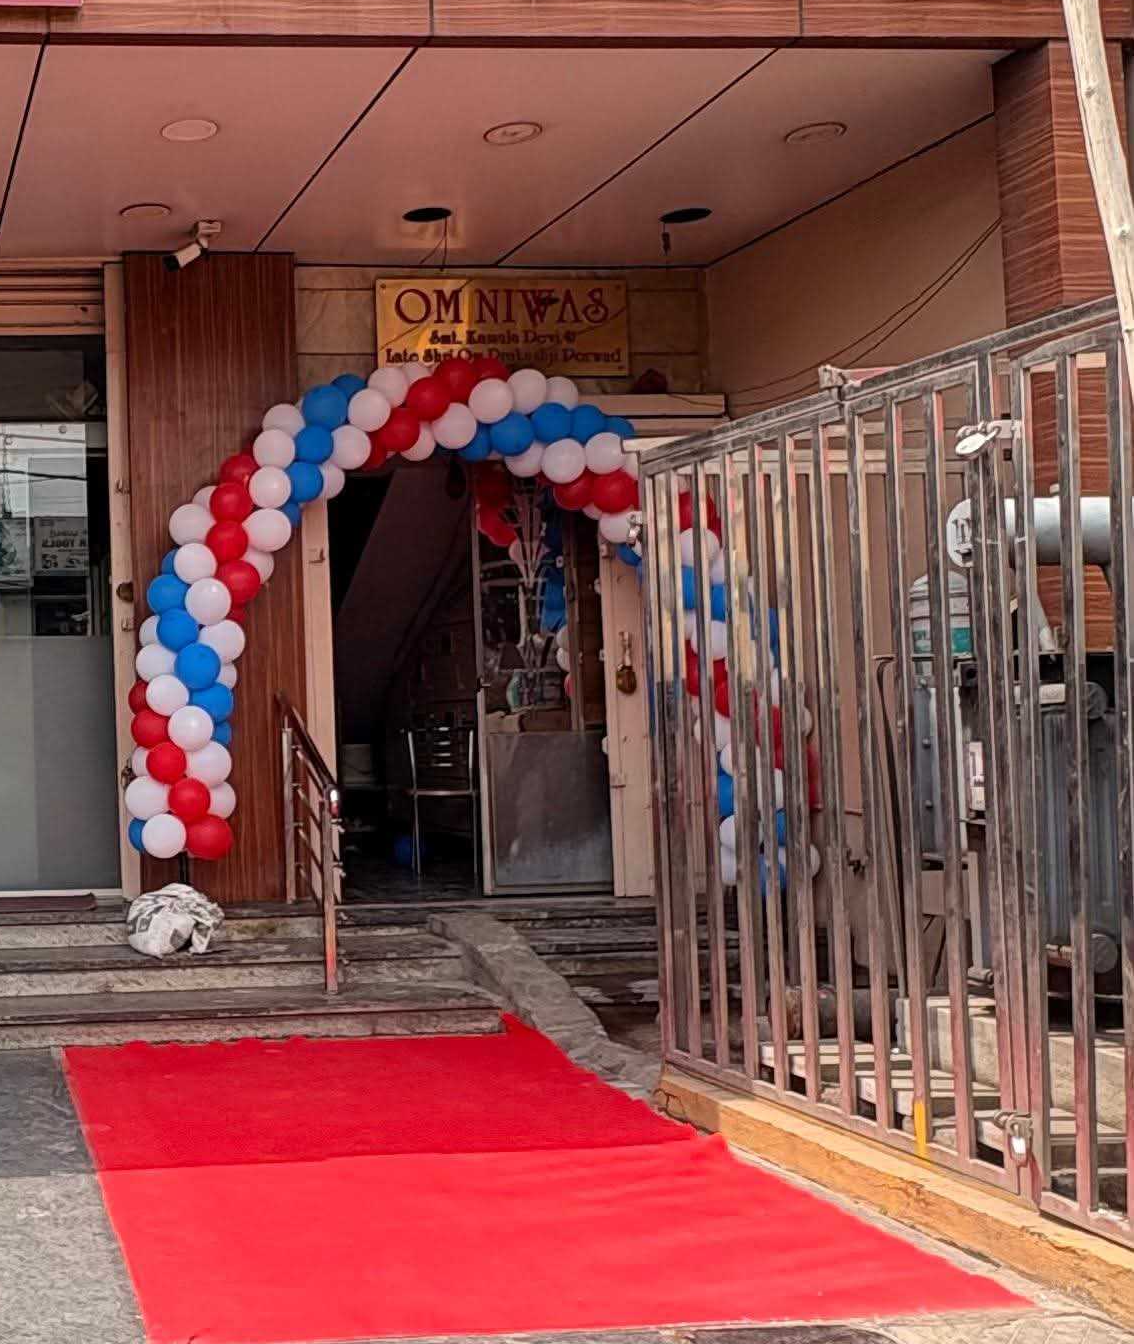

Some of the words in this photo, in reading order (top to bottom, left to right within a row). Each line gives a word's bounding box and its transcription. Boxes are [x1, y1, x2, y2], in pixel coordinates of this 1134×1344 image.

[394, 288, 463, 325] OM
[477, 287, 610, 326] NIWAS
[386, 348, 419, 363] Late
